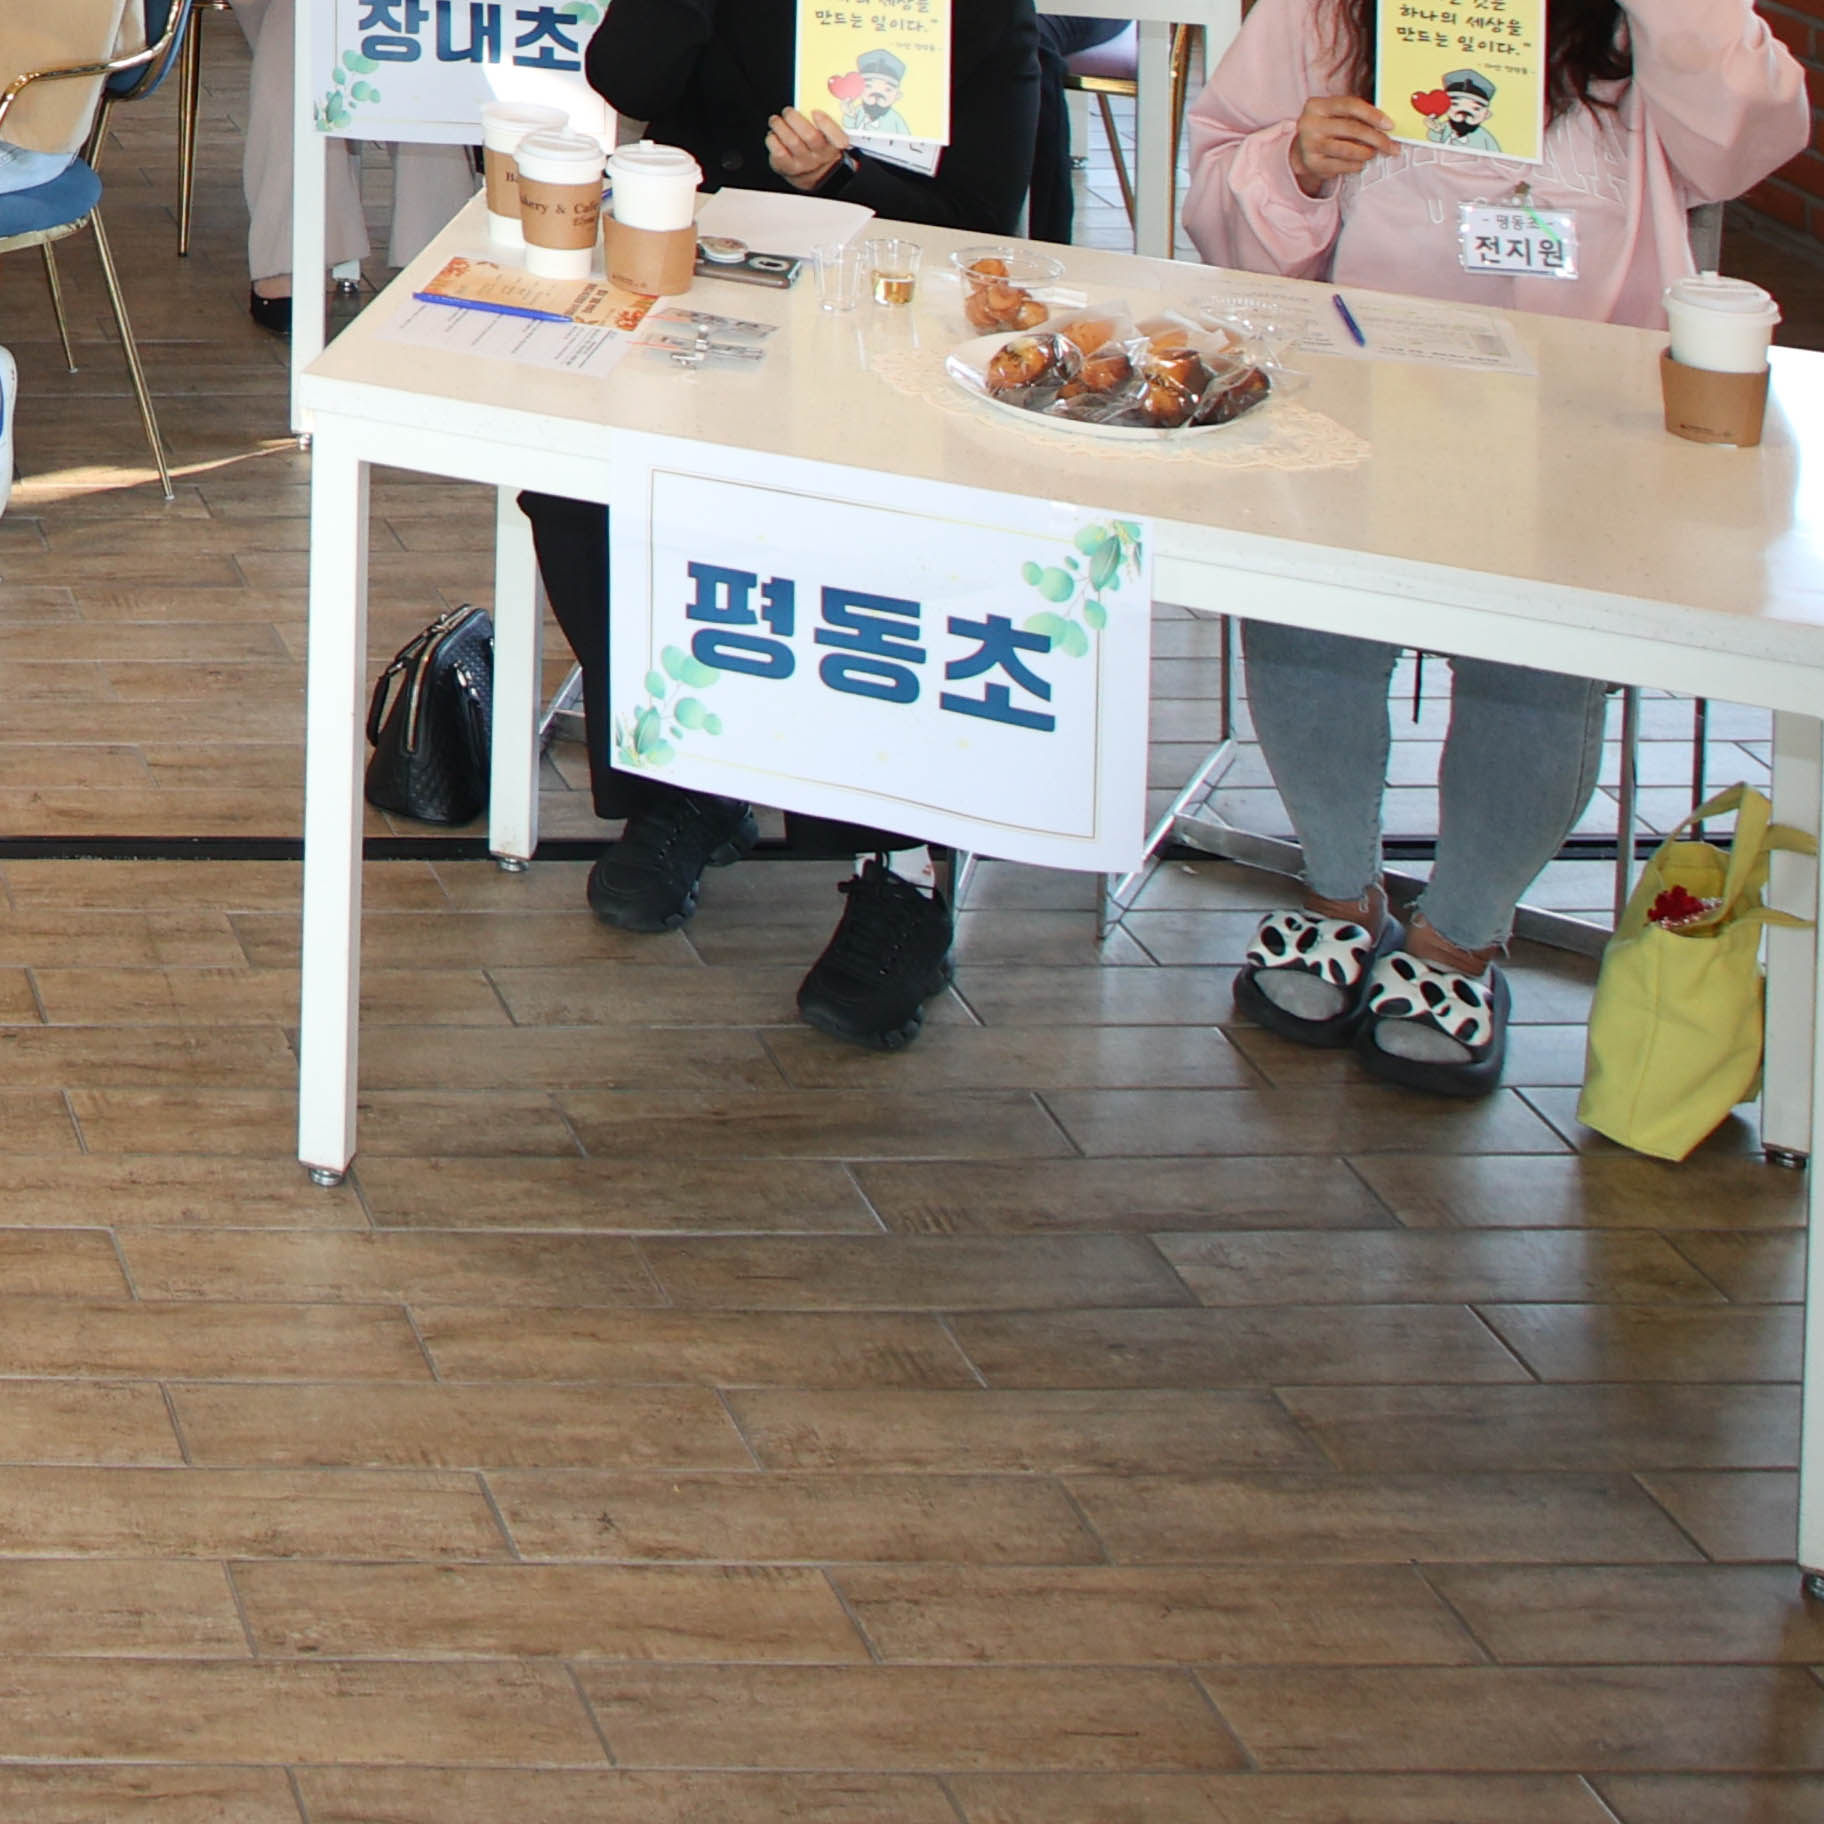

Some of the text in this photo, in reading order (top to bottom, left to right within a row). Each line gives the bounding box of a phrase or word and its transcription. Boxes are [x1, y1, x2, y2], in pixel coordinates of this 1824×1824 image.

[815, 9, 862, 28] 만드는
[1400, 4, 1522, 37] 하나의 세상을
[1396, 26, 1448, 47] 만드는
[1475, 234, 1565, 269] 전지원
[686, 560, 1056, 733] 평동초
